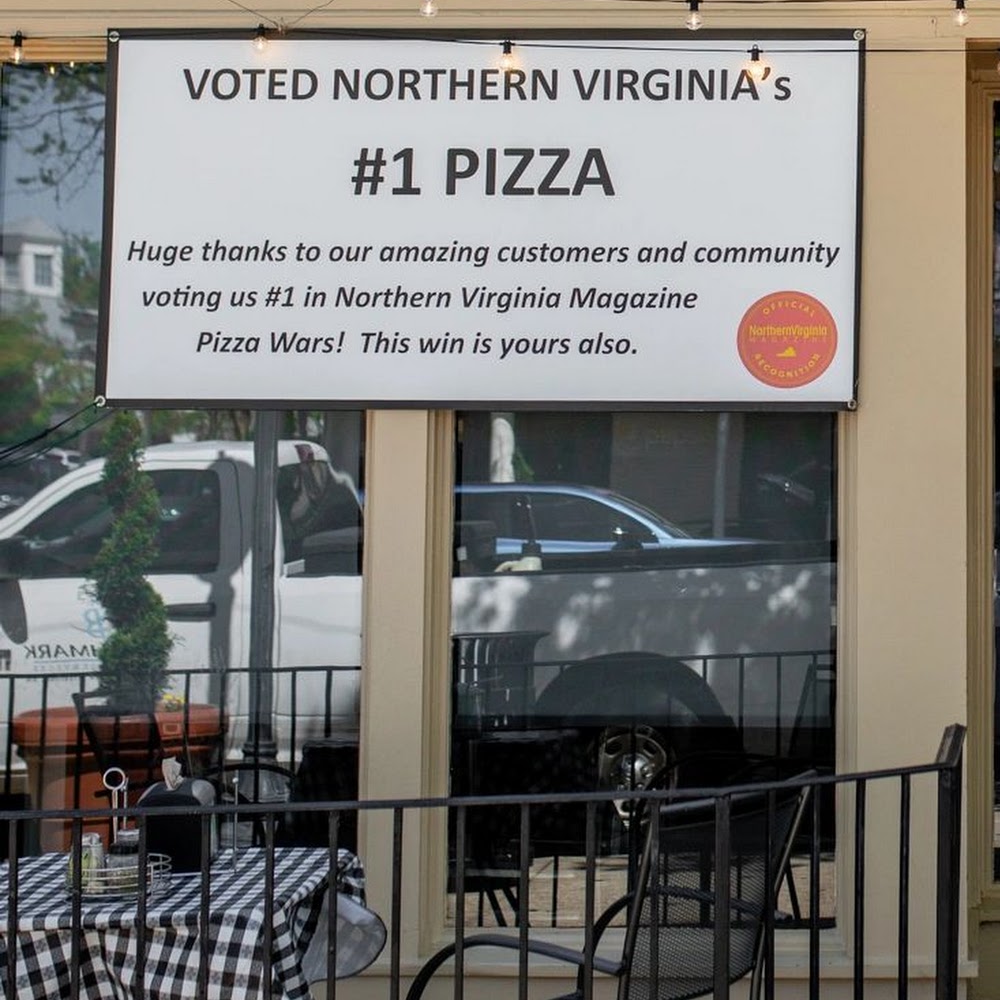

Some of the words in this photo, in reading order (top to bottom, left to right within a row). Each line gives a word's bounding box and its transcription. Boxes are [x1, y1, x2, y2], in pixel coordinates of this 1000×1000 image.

[184, 68, 318, 100] VOTED
[333, 68, 558, 101] NORTHERN
[573, 65, 791, 101] VIRGINIA's
[352, 147, 421, 196] #1
[445, 148, 616, 196] PIZZA
[127, 240, 194, 267] Huge
[202, 239, 288, 262] thanks
[295, 242, 321, 262] to
[329, 246, 373, 262] our
[379, 240, 490, 268] amazing
[497, 243, 630, 263] customers
[637, 240, 688, 263] and
[694, 241, 841, 268] community
[142, 285, 222, 313] voting
[230, 291, 258, 308] us
[265, 286, 294, 308] #1
[303, 285, 327, 308] in
[335, 285, 451, 308] Northern
[461, 286, 562, 314] Virginia
[569, 286, 698, 314] Magazine
[762, 300, 816, 317] OFFICIAL
[196, 331, 261, 353] Pizza
[270, 331, 346, 354] Wars!
[361, 331, 411, 354] This
[419, 331, 465, 354] win
[472, 331, 492, 354] is
[499, 338, 571, 360] yours
[578, 331, 637, 355] also.
[753, 353, 821, 378] RECOGNITION
